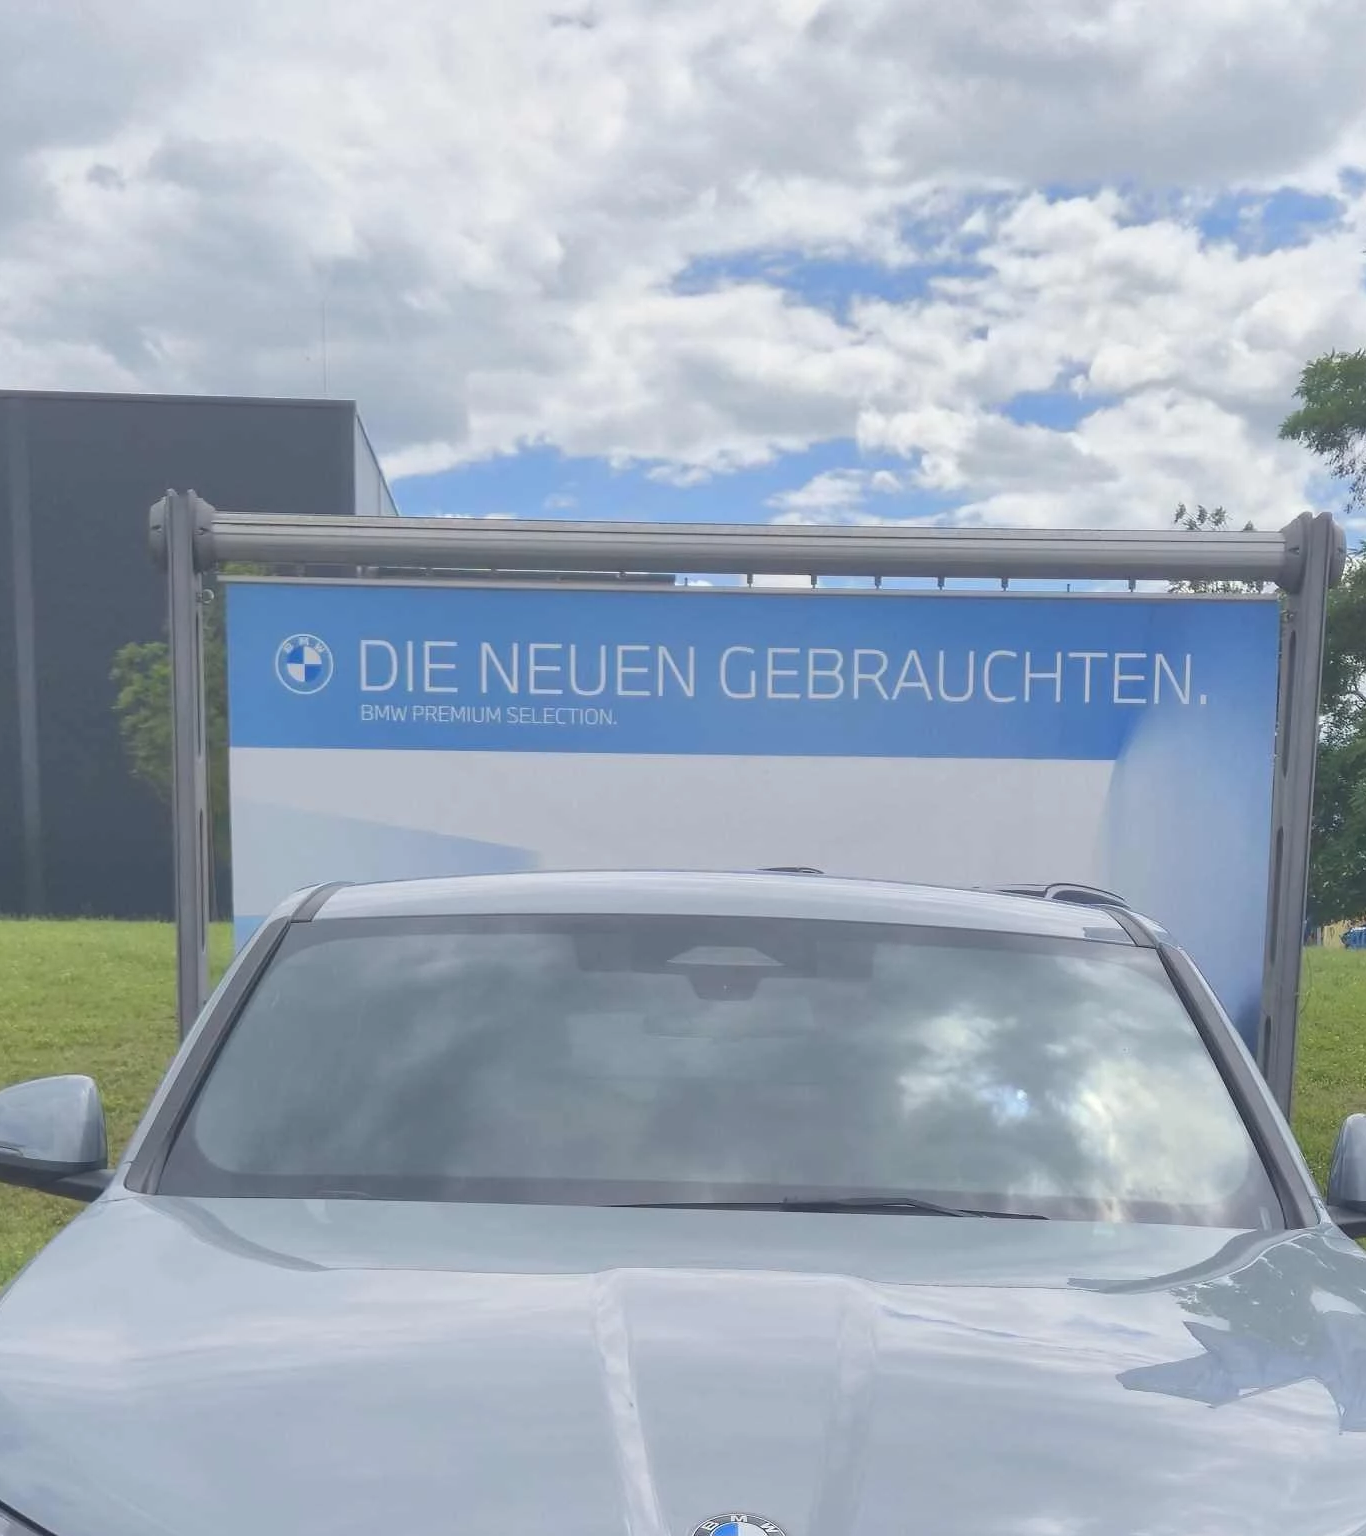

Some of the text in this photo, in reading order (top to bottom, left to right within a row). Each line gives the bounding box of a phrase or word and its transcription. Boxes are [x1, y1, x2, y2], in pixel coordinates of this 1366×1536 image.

[360, 639, 1208, 706] DIE NEUEN GEBRAUCHTEN.
[361, 704, 618, 726] BMW PREMIUM SELECTION.
[701, 1514, 779, 1534] BMW
